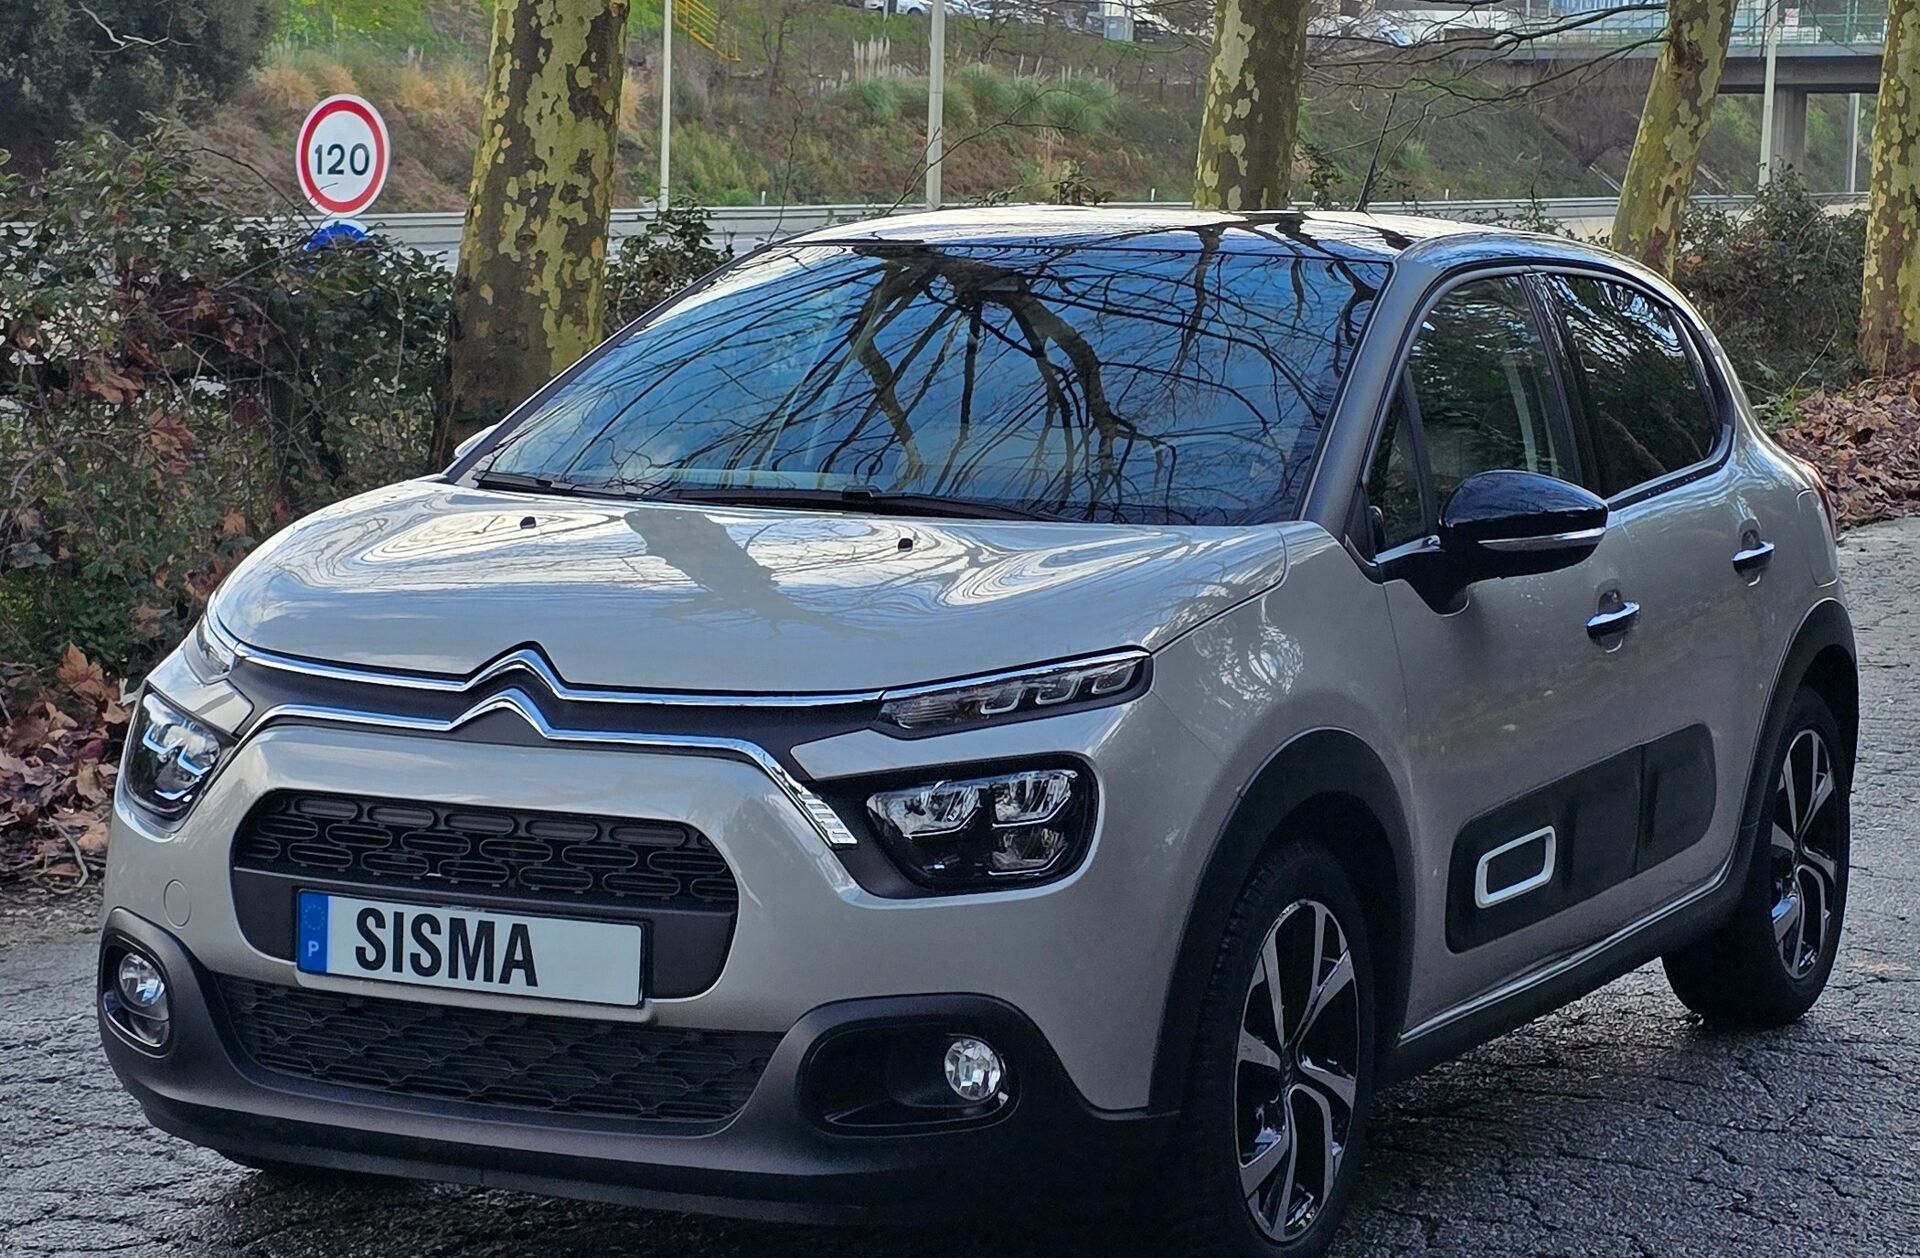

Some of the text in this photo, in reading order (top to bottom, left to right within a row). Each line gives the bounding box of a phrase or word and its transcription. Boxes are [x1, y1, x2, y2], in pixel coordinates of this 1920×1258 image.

[314, 143, 370, 176] 120
[308, 940, 320, 957] P
[355, 907, 538, 987] SISMA
